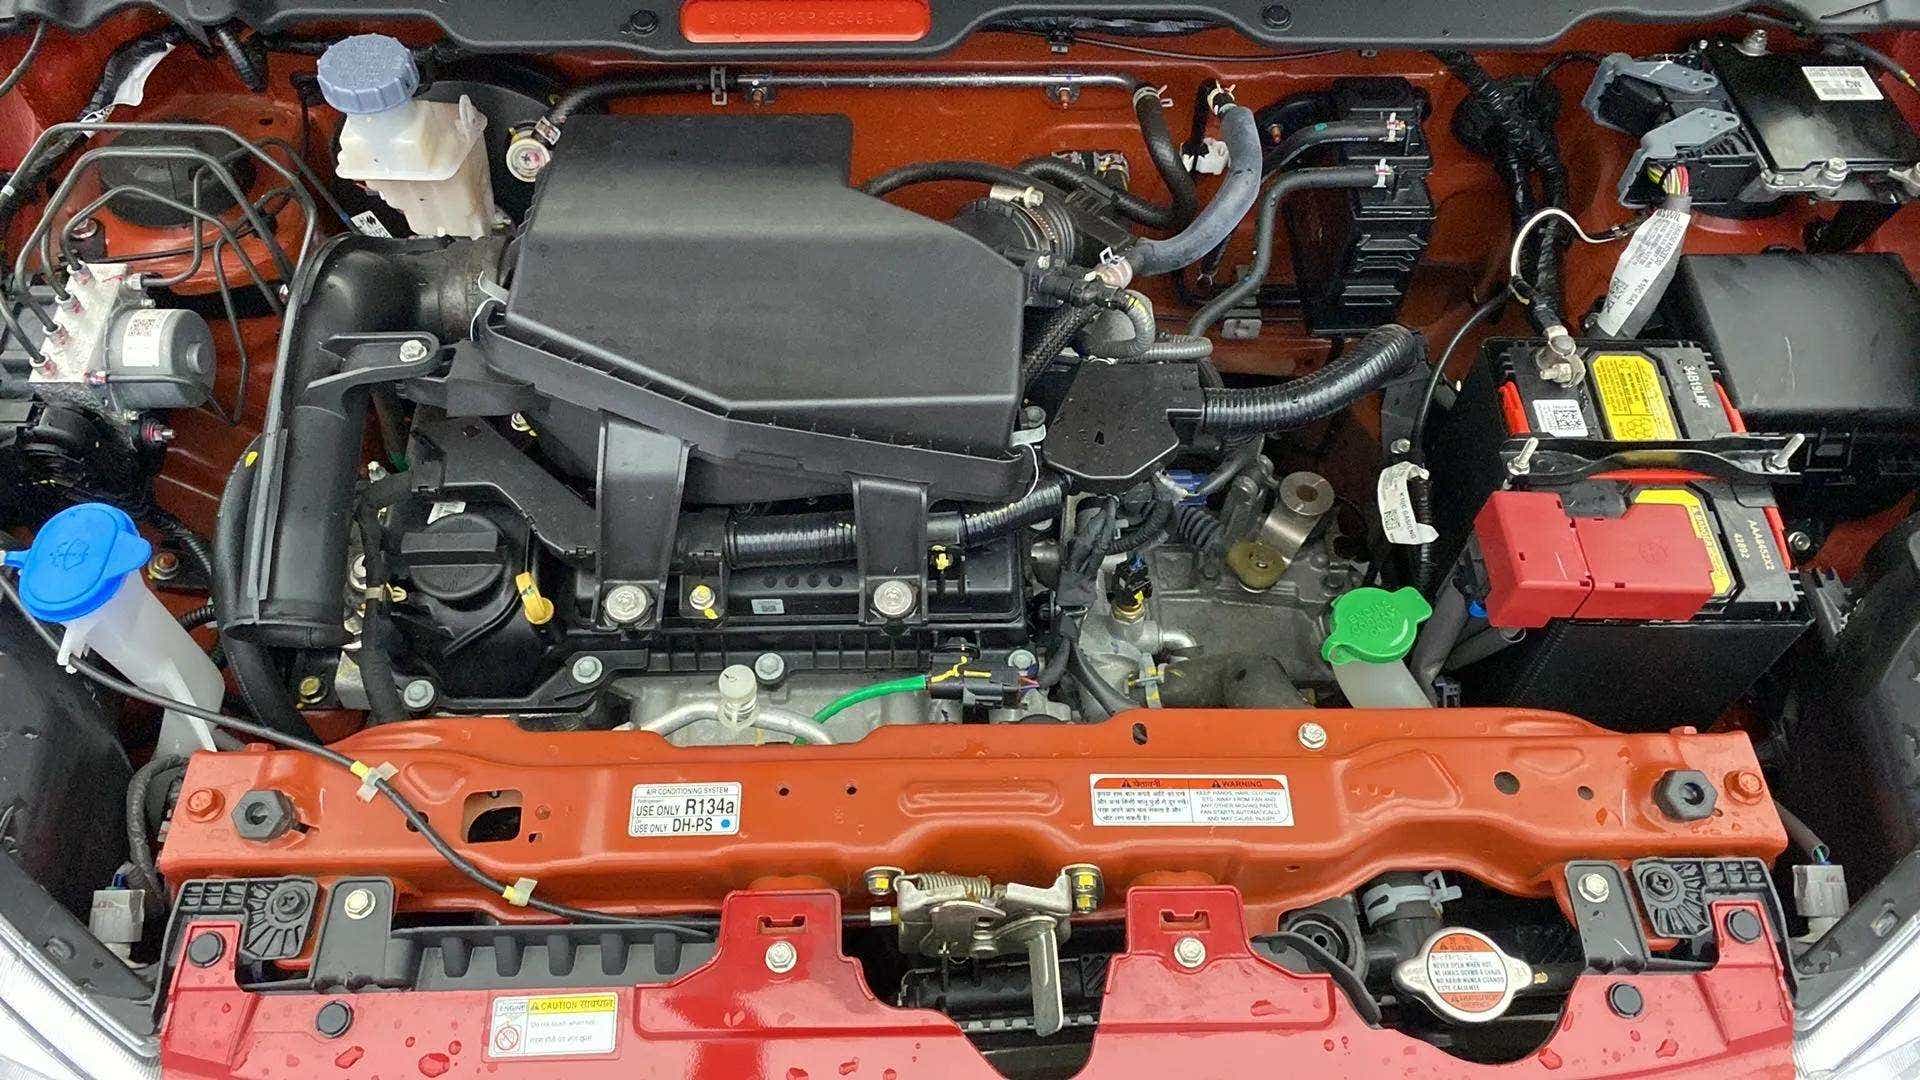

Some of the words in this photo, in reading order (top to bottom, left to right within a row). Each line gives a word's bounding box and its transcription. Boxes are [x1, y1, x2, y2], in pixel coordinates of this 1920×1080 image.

[1684, 365, 1711, 409] 34B19LMF
[1222, 780, 1263, 788] WARNING
[658, 787, 703, 795] CONDITIONING
[704, 786, 729, 794] SYSTEM
[636, 805, 655, 816] USE
[656, 804, 680, 816] ONLY
[685, 798, 734, 815] R134a
[634, 824, 648, 833] USE
[649, 823, 668, 833] ONLY
[672, 817, 713, 832] DH-PS
[1433, 961, 1450, 969] NEVER
[1452, 961, 1465, 969] OPEN
[541, 1001, 577, 1011] CAUTION
